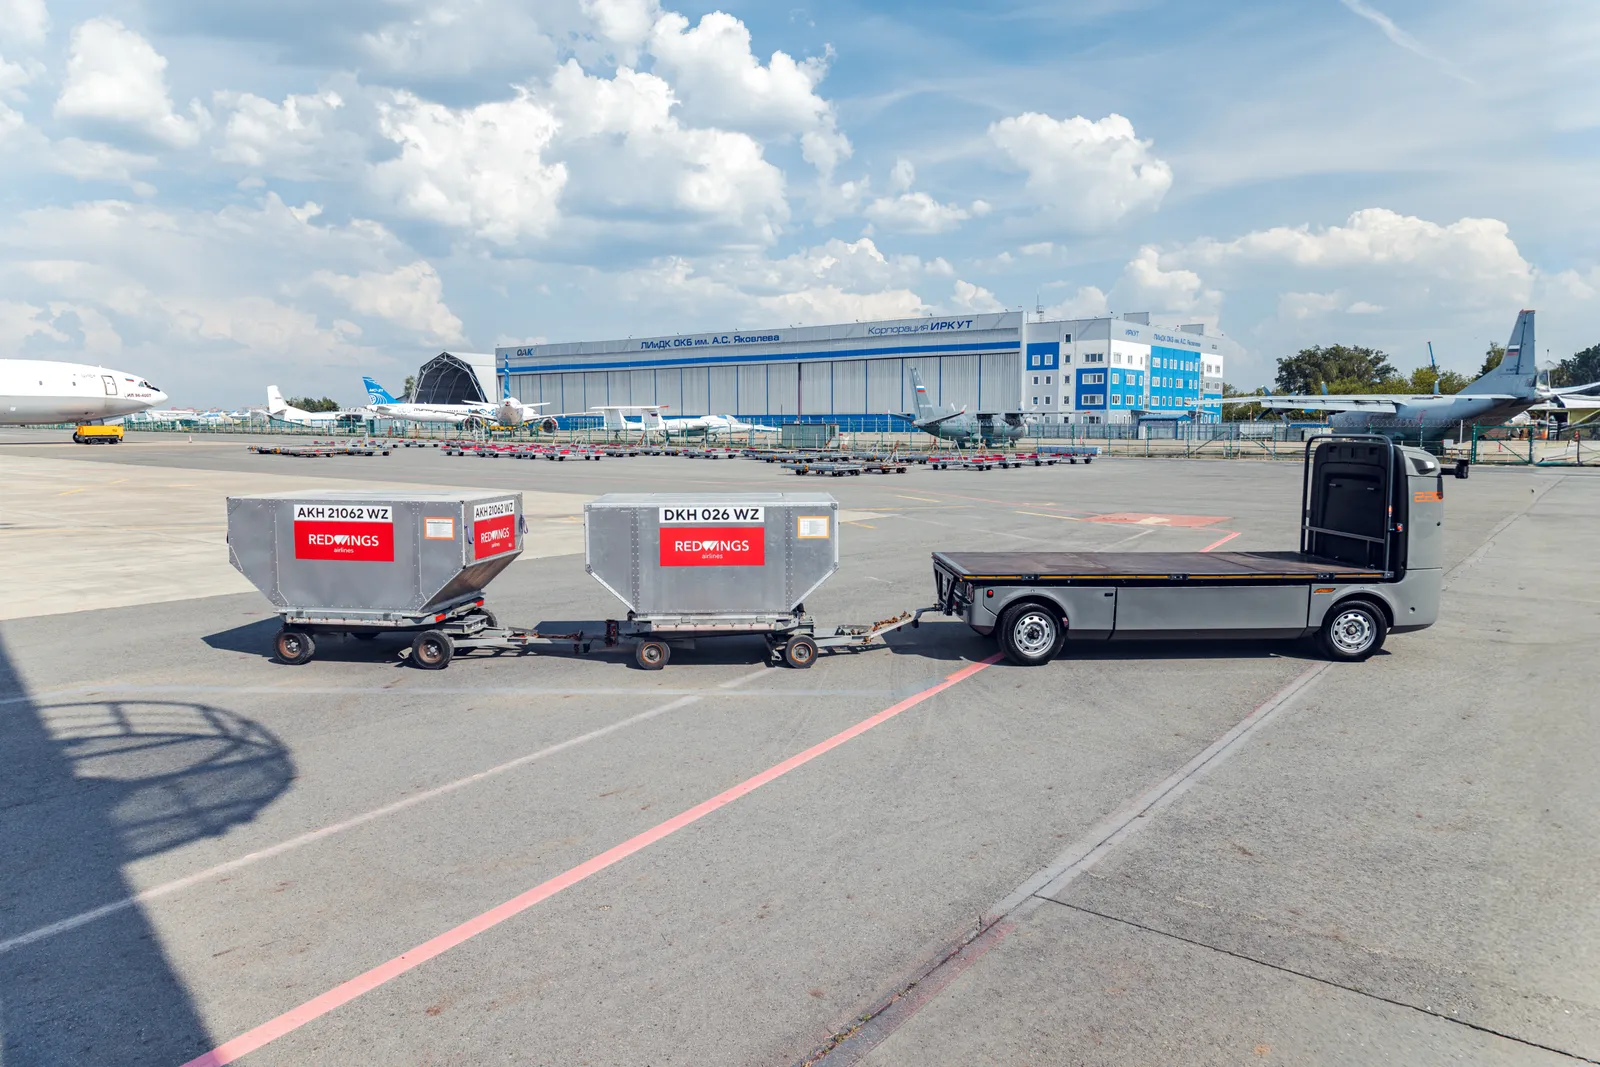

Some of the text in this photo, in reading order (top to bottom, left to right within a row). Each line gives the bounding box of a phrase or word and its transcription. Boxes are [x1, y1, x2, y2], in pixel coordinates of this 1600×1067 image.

[868, 320, 973, 336] Корпорация ИРКУТ
[673, 338, 693, 347] ОКБ
[733, 335, 780, 343] Яковлева
[297, 507, 389, 520] AKH 21062 WZ
[664, 508, 760, 521] DKH 026 WZ
[308, 533, 379, 547] REDWINGS
[674, 540, 750, 552] REDWINGS
